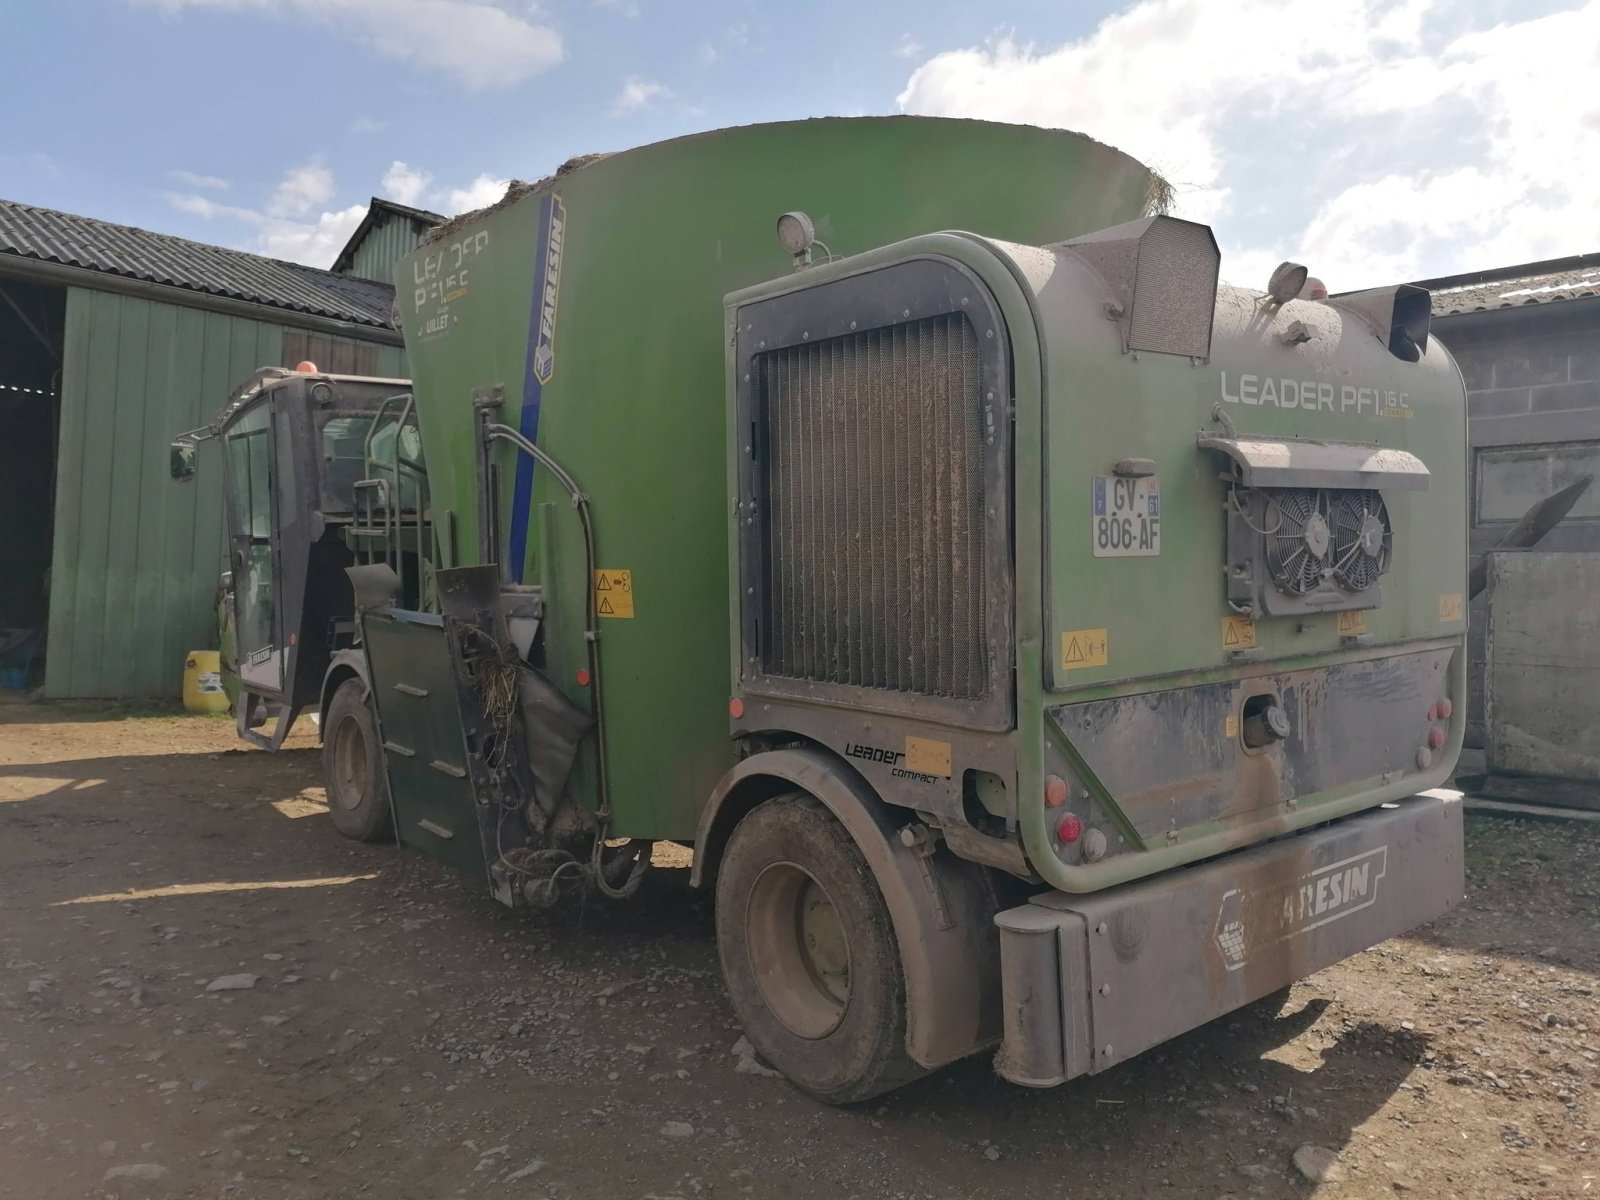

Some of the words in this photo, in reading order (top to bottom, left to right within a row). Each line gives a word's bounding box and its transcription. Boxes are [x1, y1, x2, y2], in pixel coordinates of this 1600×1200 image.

[541, 218, 563, 339] FARESIN
[1220, 370, 1335, 412] LEADER
[1098, 517, 1160, 550] 806-AF
